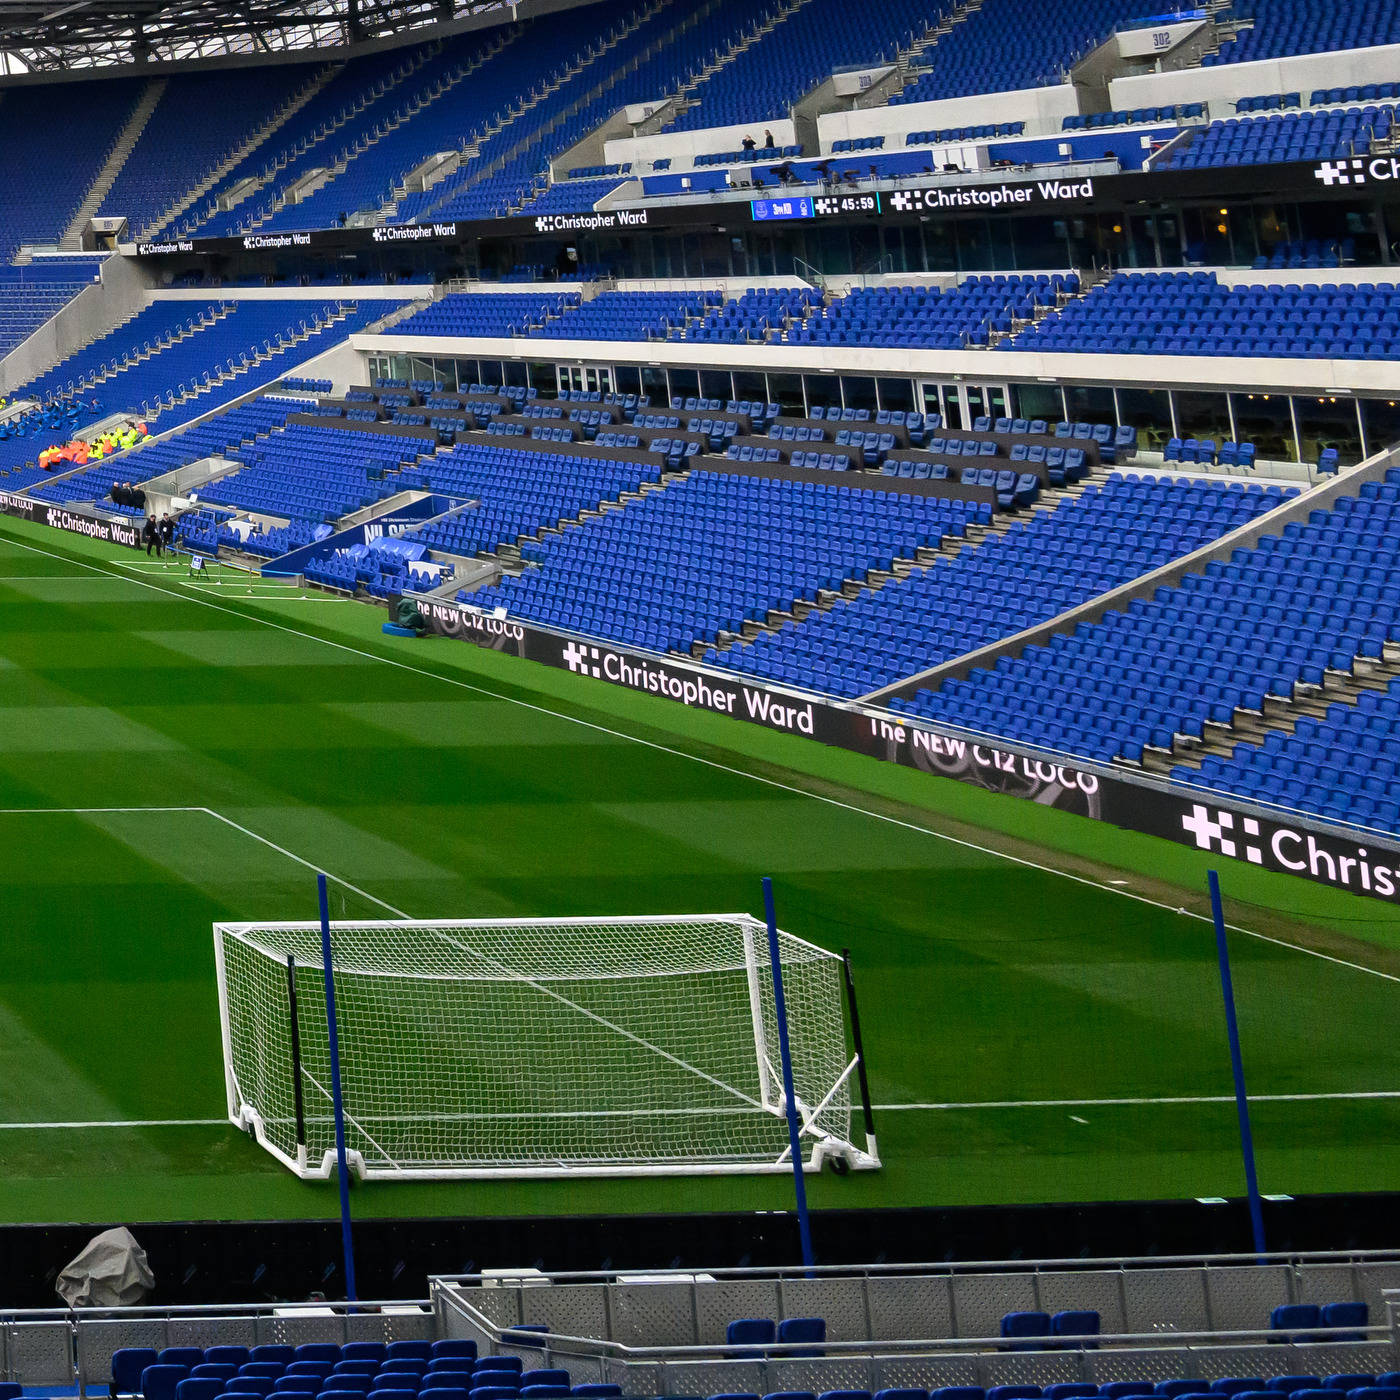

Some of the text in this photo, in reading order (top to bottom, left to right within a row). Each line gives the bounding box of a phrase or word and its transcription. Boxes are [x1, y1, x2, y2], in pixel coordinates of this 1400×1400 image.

[1153, 32, 1171, 47] 302
[841, 197, 875, 211] 45:59
[925, 179, 1094, 207] Christopher Ward
[554, 209, 648, 230] Christopher Ward
[255, 233, 311, 248] Christopher Ward
[387, 223, 456, 241] Christopher Ward
[148, 240, 193, 254] Christopher Ward
[61, 514, 136, 546] Christopher Ward
[416, 600, 430, 616] he
[432, 606, 460, 624] NEW
[486, 618, 525, 641] LOCO
[603, 653, 815, 735] Christopher Ward
[870, 718, 1099, 795] The NEW C12 LOCO
[1271, 829, 1400, 897] Chris
